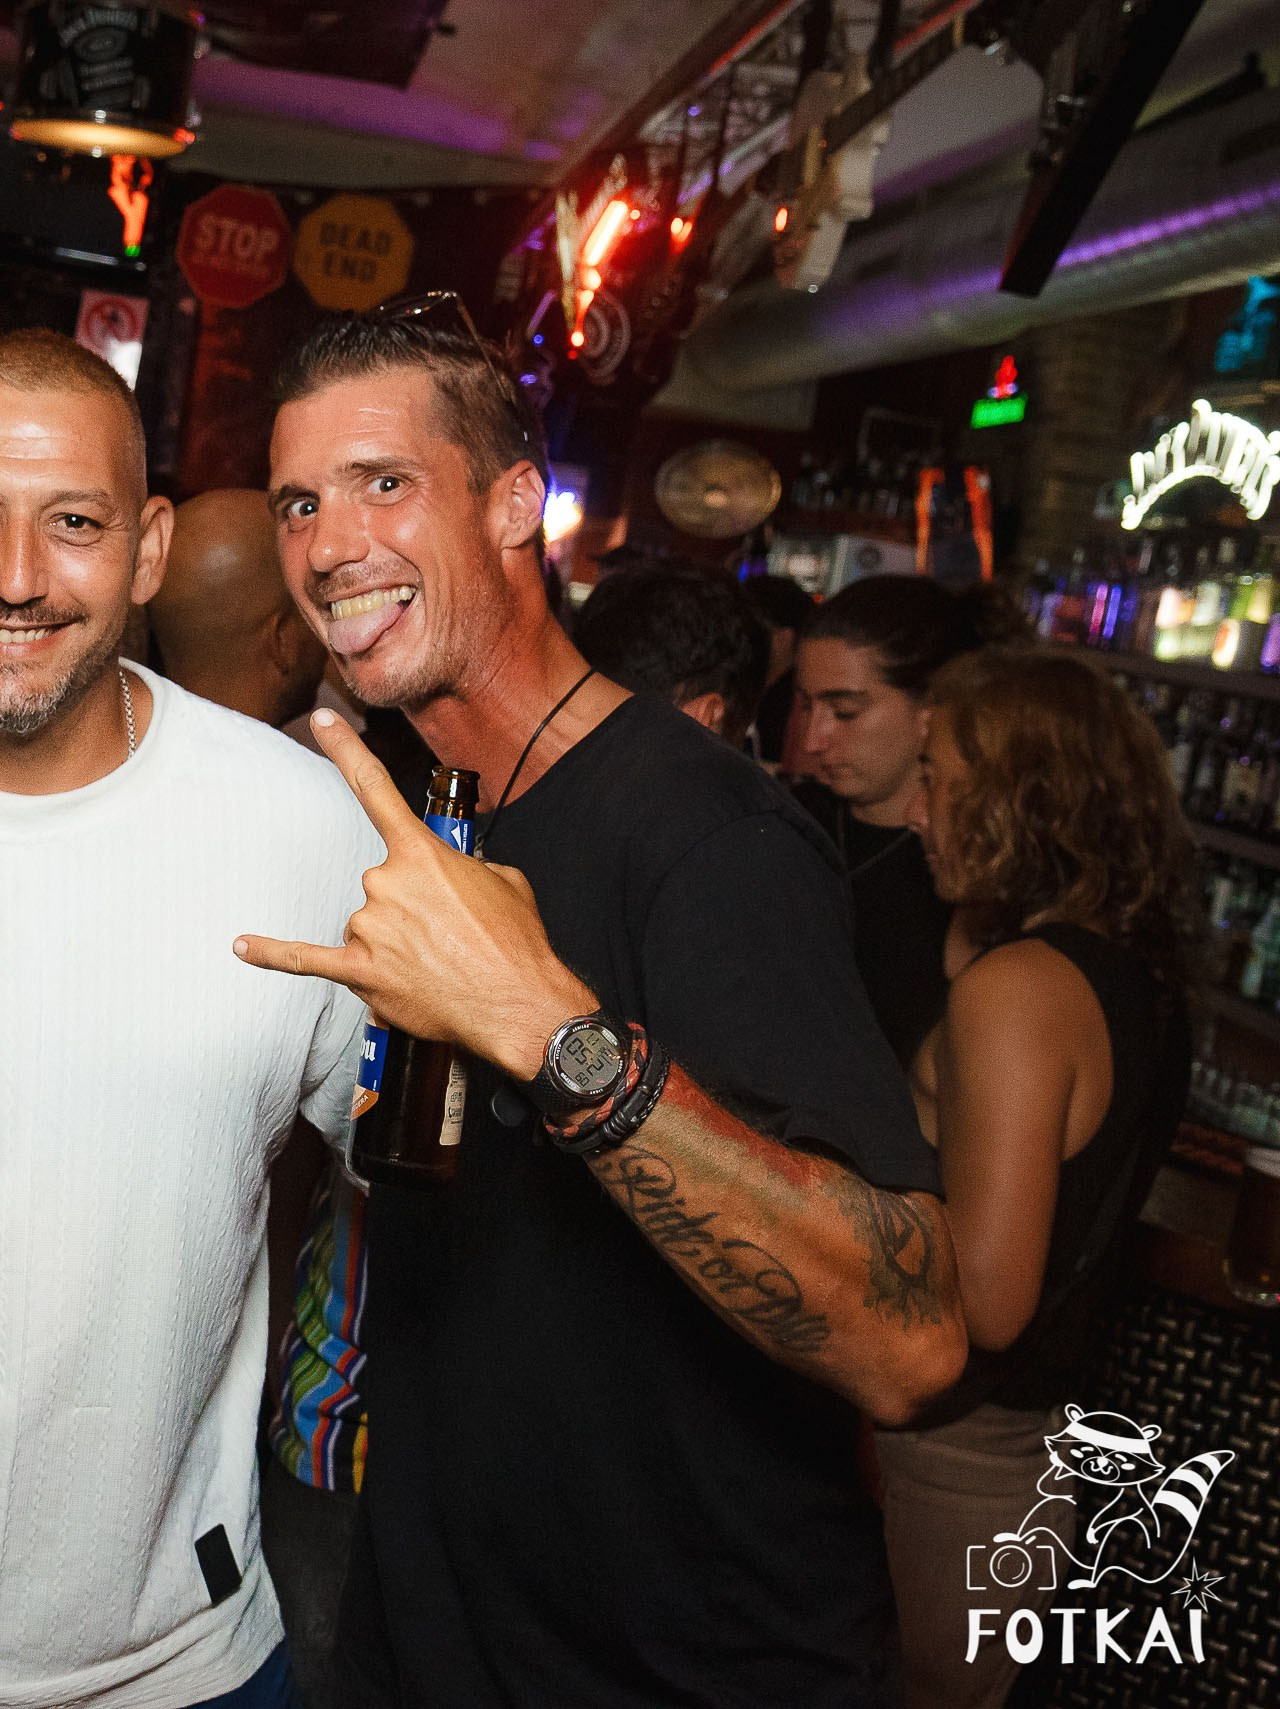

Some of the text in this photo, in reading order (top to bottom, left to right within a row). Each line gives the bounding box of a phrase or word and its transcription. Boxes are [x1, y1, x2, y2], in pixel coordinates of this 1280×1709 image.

[195, 212, 279, 262] STOP
[321, 221, 393, 256] DEAD
[323, 251, 378, 284] END
[698, 1257, 756, 1294] or
